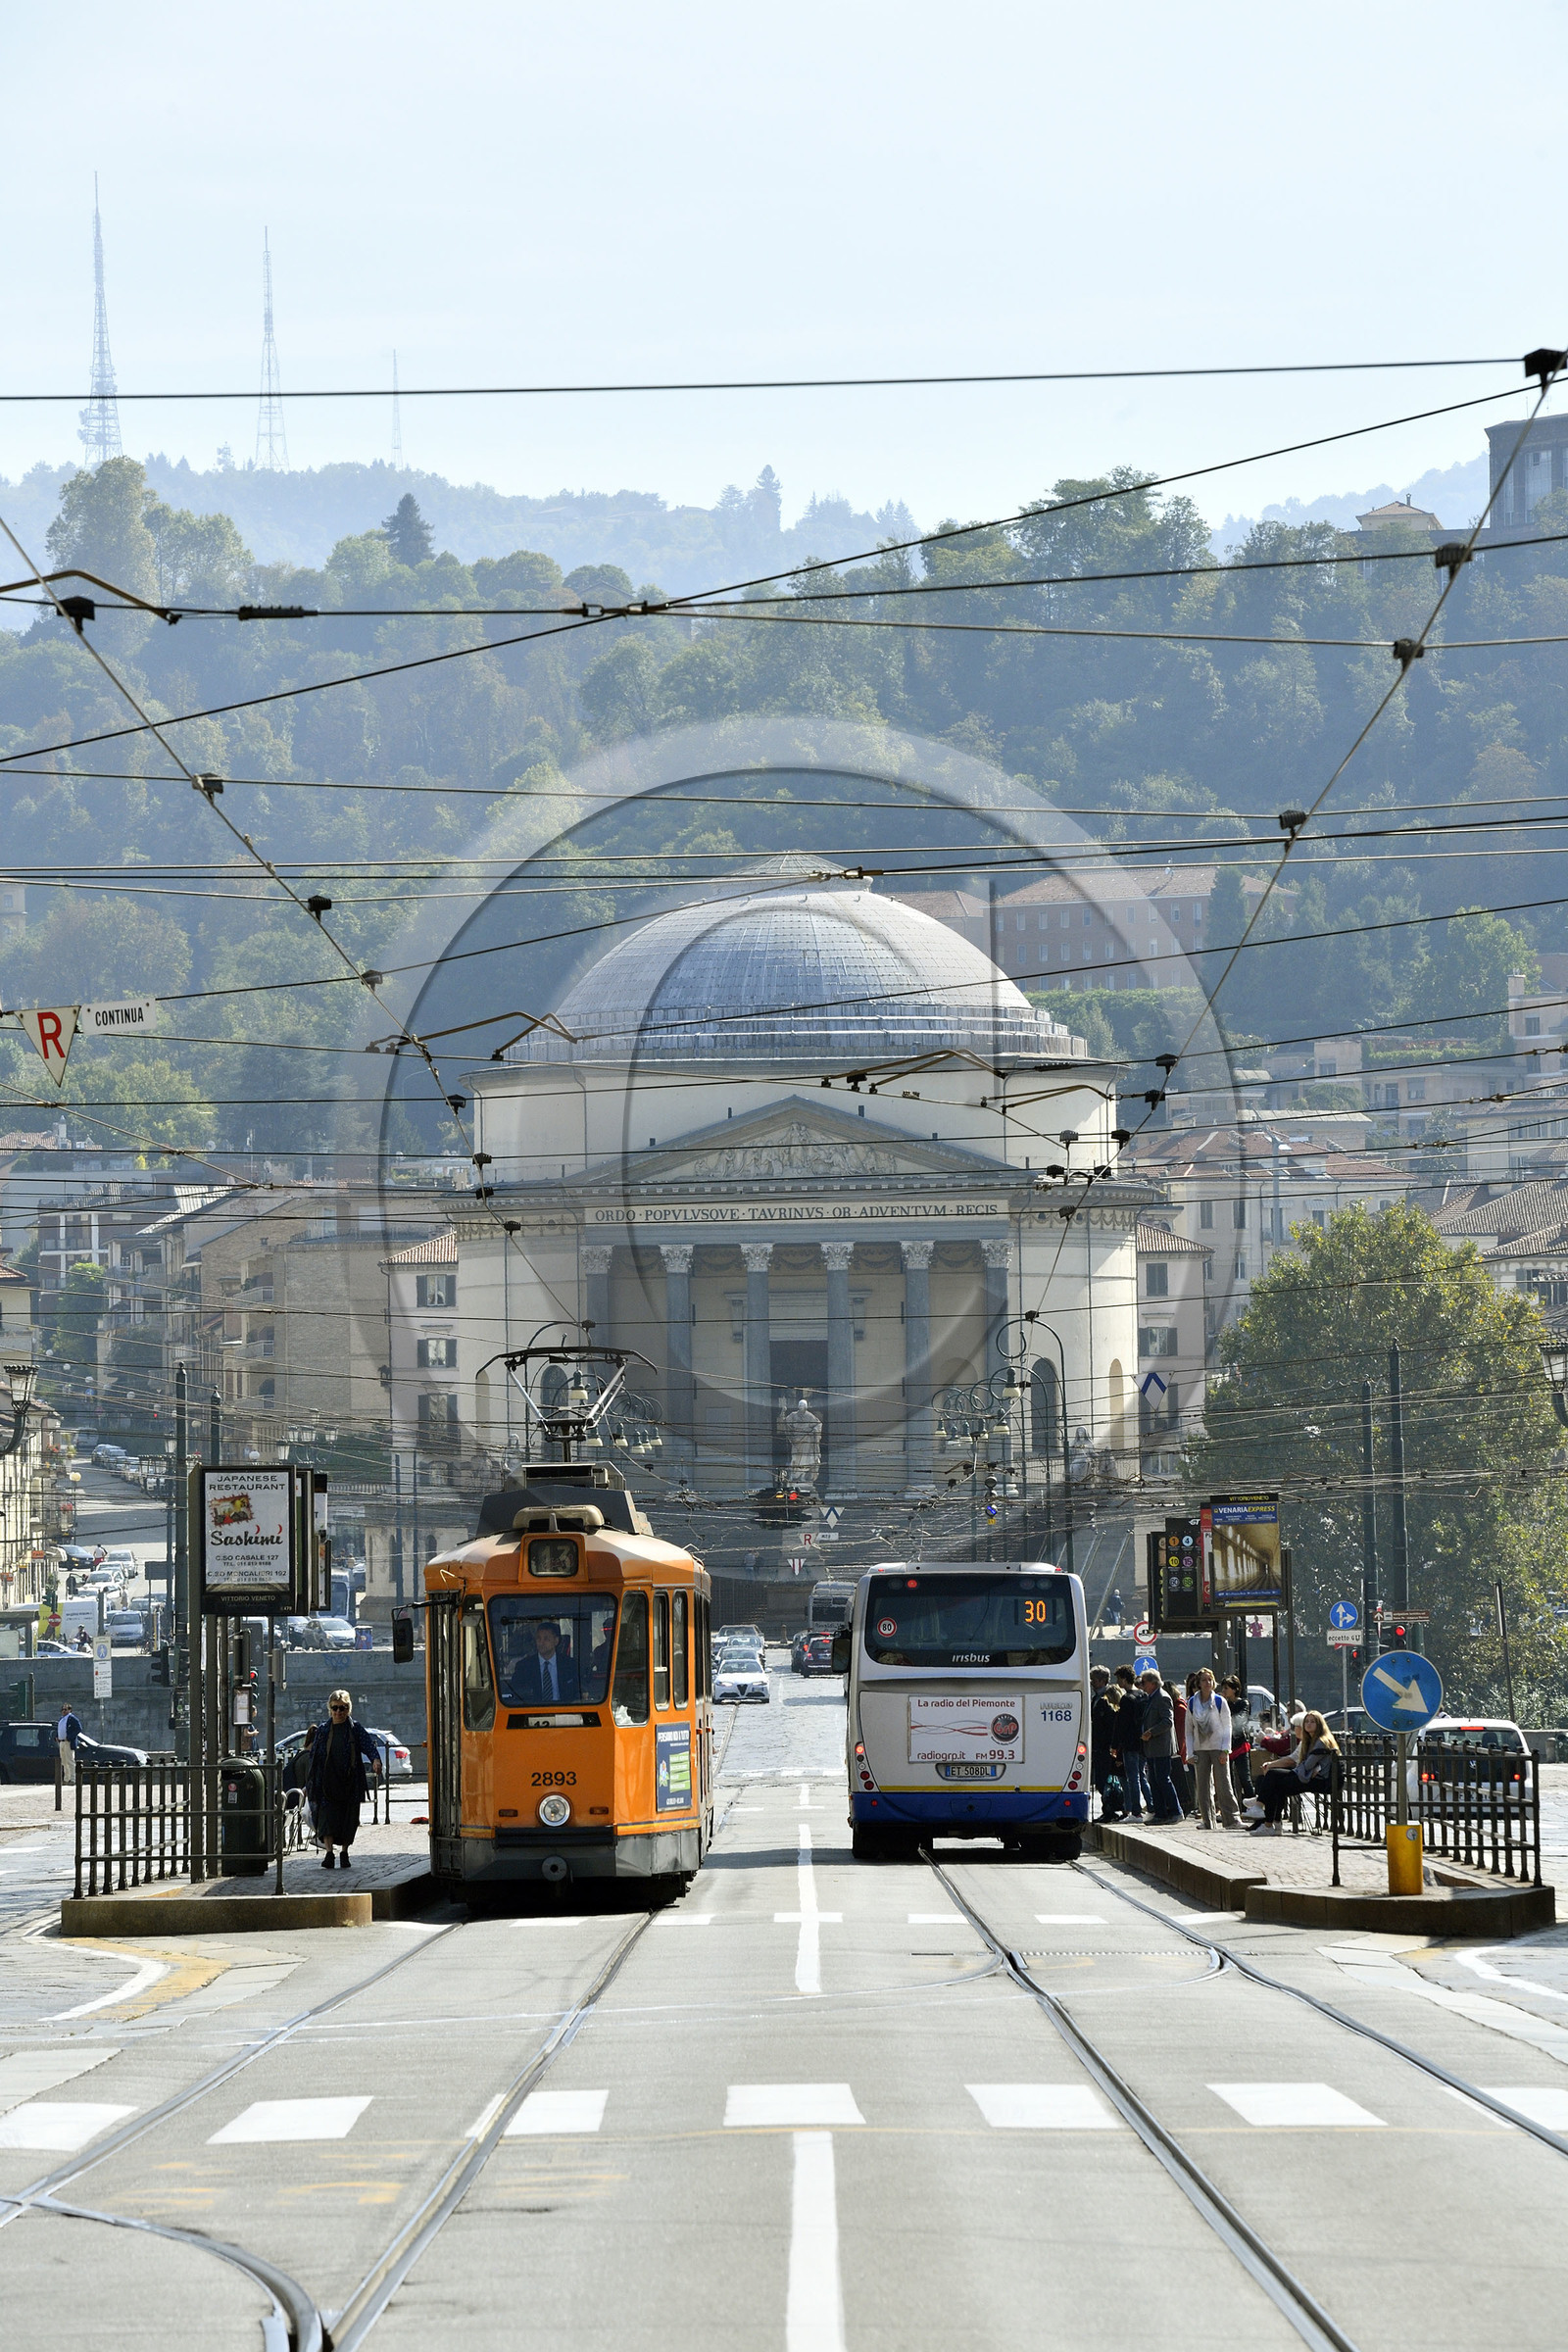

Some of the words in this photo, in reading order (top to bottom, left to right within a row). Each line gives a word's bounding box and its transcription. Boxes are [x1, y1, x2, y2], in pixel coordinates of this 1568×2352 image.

[95, 1007, 144, 1026] CONTINUA
[37, 1011, 66, 1059] R
[595, 1210, 636, 1221] ORDO
[645, 1209, 740, 1221] POPVLVSQVE
[748, 1207, 824, 1219] TAVRINVS
[832, 1207, 851, 1218] OB
[859, 1205, 947, 1217] ADVENTVM
[211, 1524, 284, 1545] Sashimi
[804, 1534, 812, 1545] R
[1024, 1600, 1046, 1623] 30
[882, 1623, 892, 1632] 80
[952, 1653, 990, 1663] irisbus
[1041, 1710, 1072, 1721] 1168
[917, 1751, 965, 1762] radiogrp.it
[989, 1750, 1015, 1760] 99.3
[951, 1767, 961, 1775] ET
[532, 1771, 577, 1786] 2893
